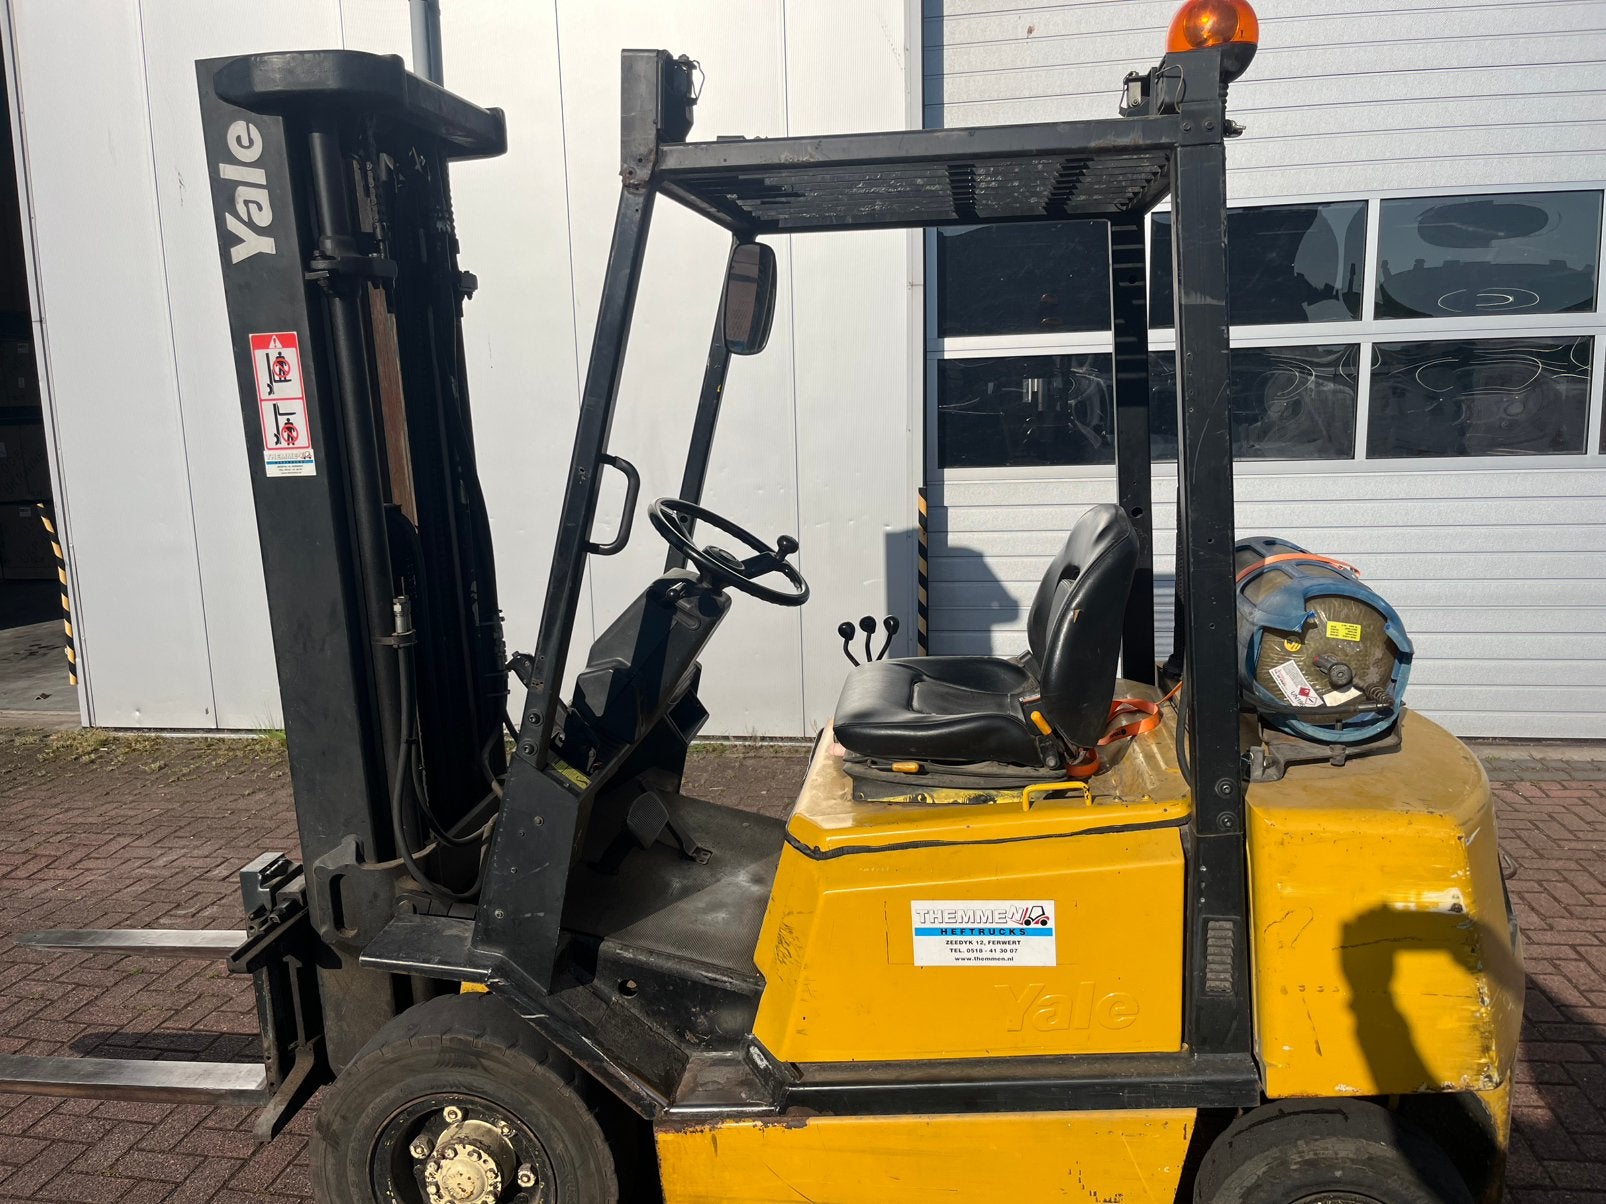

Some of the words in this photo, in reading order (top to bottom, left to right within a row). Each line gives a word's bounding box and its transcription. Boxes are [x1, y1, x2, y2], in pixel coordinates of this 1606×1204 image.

[219, 120, 276, 264] Yale
[915, 904, 1025, 924] THEMMEN
[940, 928, 1026, 936] HEFTRUCKS
[994, 981, 1140, 1032] Yale
